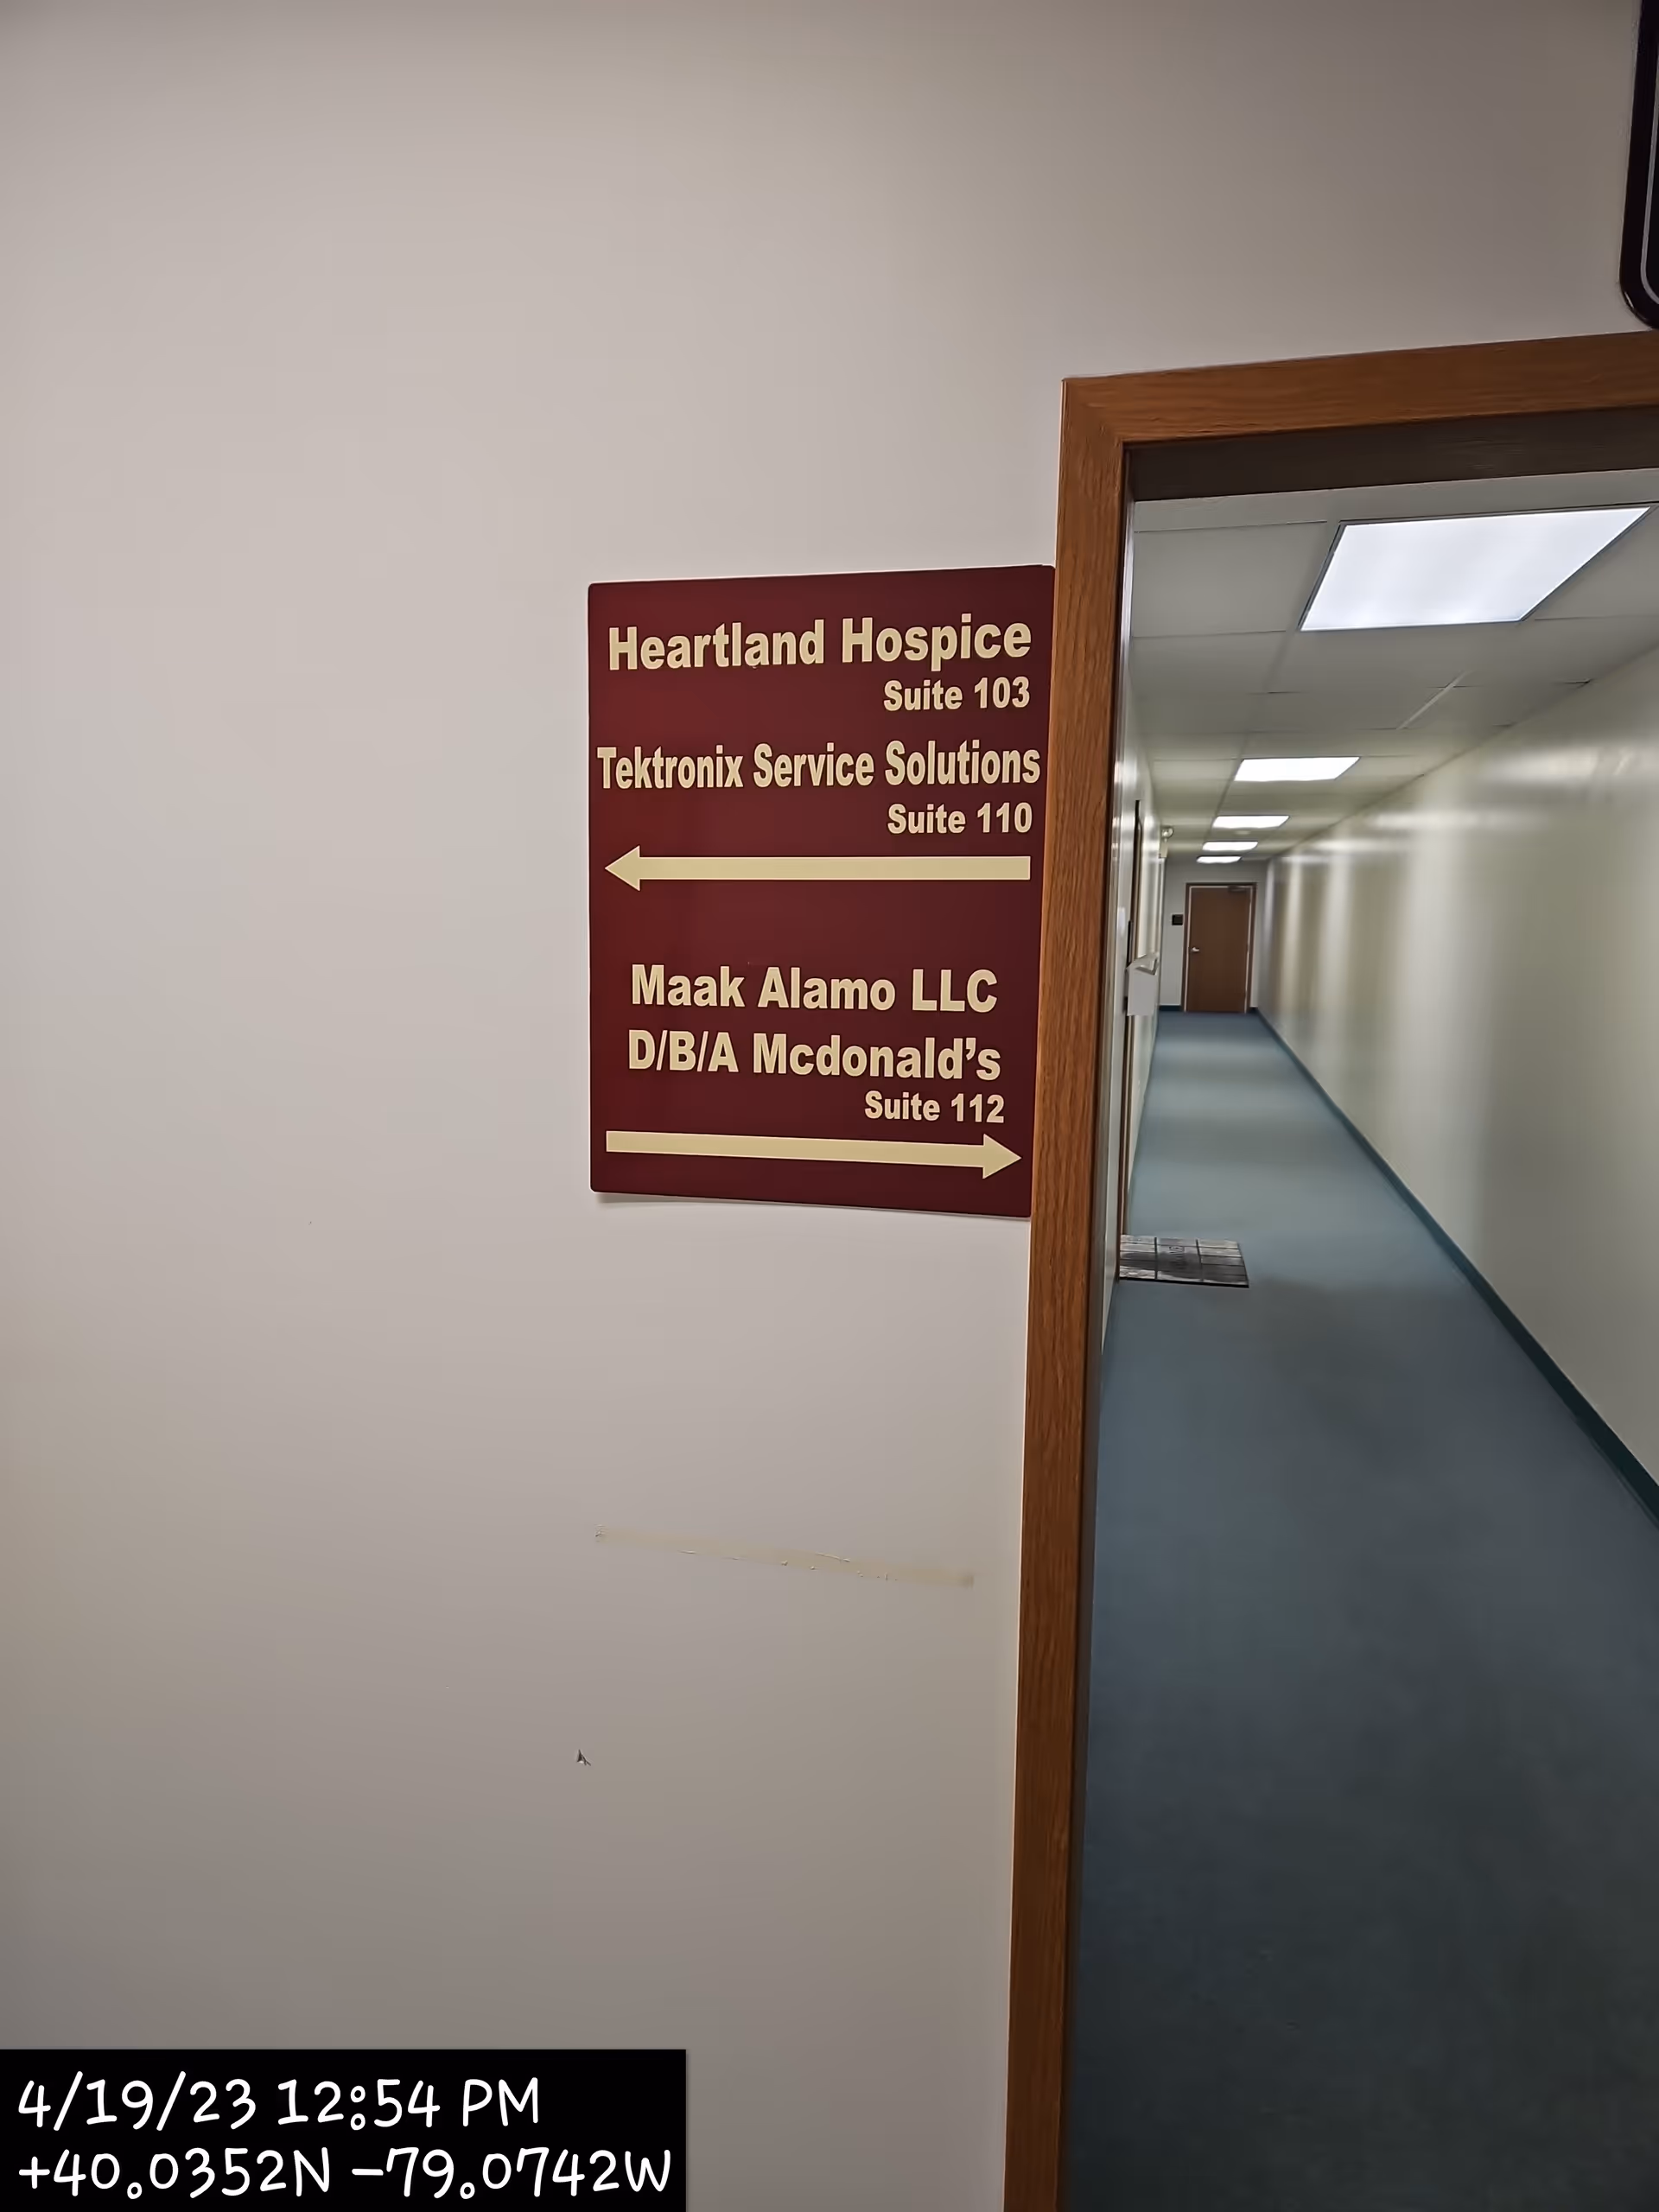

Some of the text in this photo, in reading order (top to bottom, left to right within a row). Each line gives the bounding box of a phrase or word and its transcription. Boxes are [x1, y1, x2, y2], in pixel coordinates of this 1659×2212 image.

[610, 613, 1031, 671] Heartland Hospice
[884, 677, 1029, 711] Suite 103
[597, 740, 1039, 789] Tektronix Service Solutions
[888, 803, 1032, 834] Suite 110
[632, 964, 996, 1012] Maak Alamo LLC
[629, 1030, 738, 1072] D/B/A
[865, 1090, 1004, 1122] Suite 112
